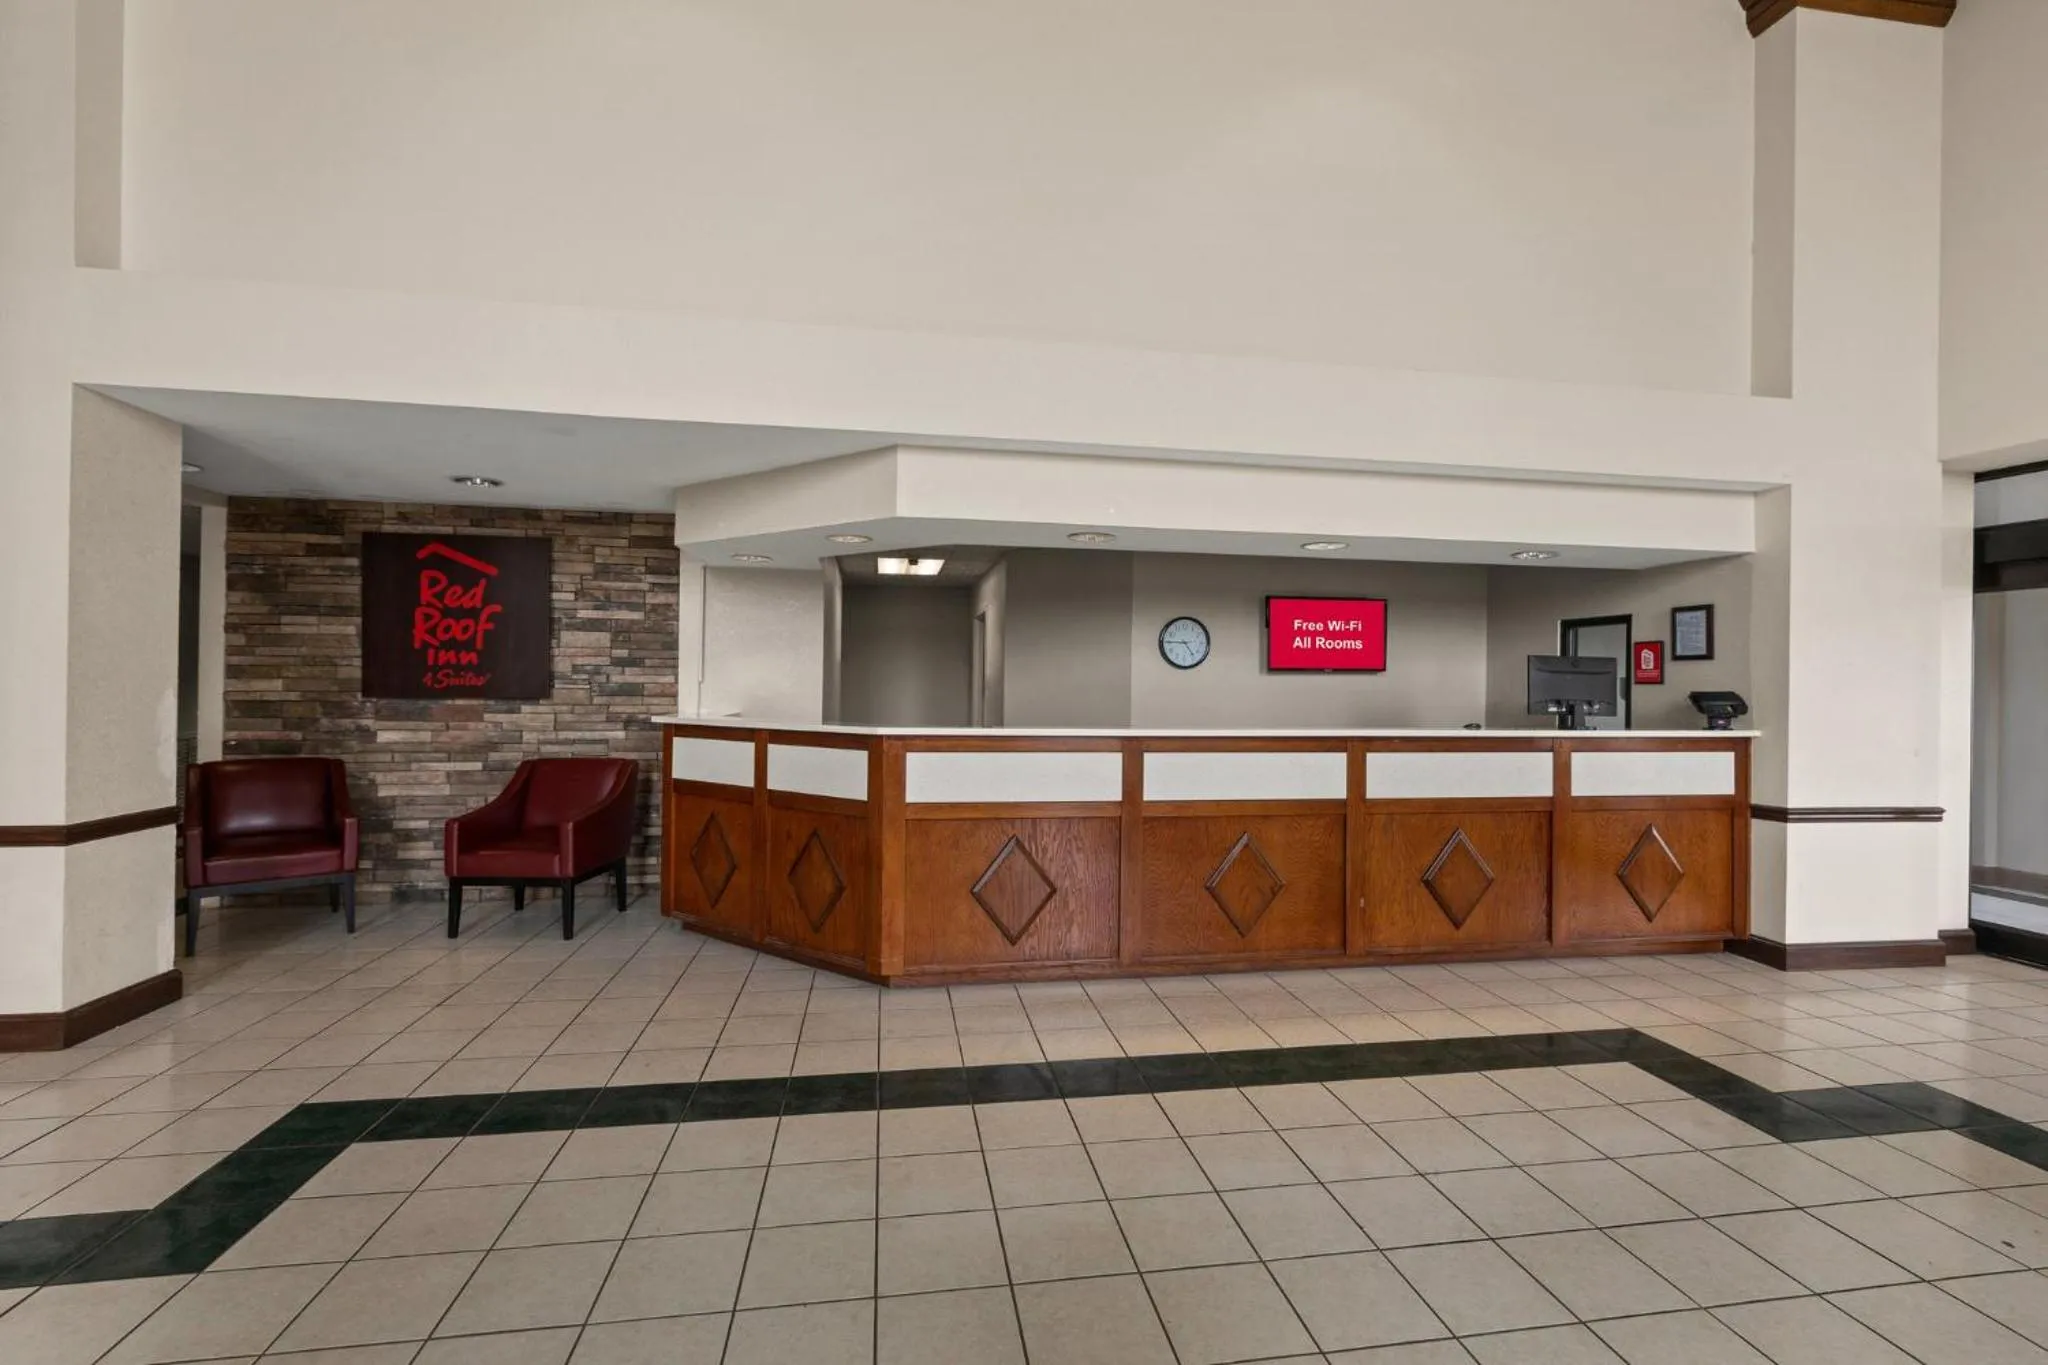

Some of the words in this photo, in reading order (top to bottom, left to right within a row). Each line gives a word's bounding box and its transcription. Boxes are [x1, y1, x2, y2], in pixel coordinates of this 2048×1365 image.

[420, 570, 487, 608] Red
[413, 605, 502, 649] Roof
[1293, 619, 1324, 631] Free
[1327, 620, 1362, 631] Wi-Fi
[1293, 636, 1311, 649] All
[1316, 636, 1363, 649] Rooms
[434, 669, 492, 689] Suites
